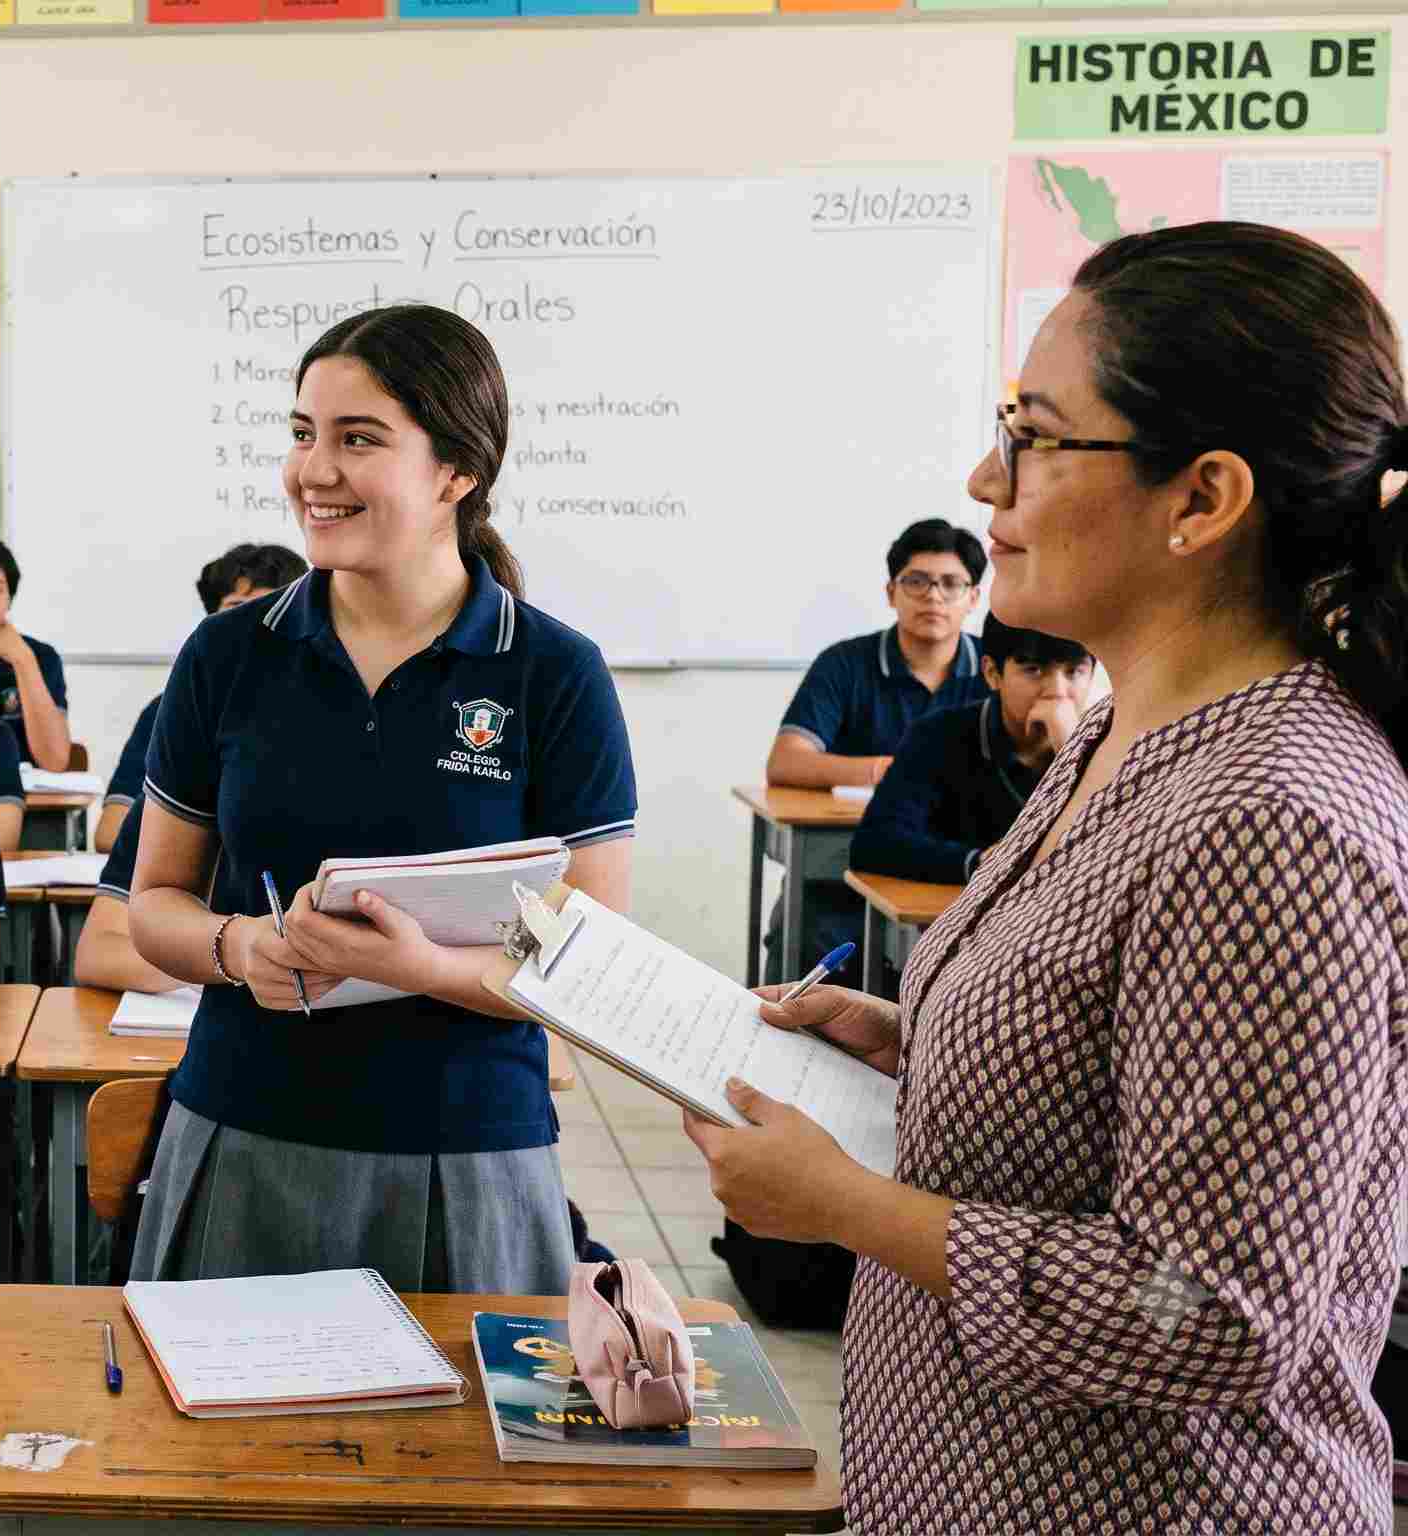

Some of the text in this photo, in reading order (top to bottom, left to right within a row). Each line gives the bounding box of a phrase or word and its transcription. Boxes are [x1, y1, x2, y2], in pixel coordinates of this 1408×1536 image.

[1029, 38, 1376, 84] HISTORIA DE
[1110, 83, 1309, 132] MÉXICO
[811, 184, 972, 224] 23/10/2023
[202, 209, 656, 270] Ecosistemas y Conservación
[454, 281, 575, 322] Orales
[535, 403, 547, 425] y
[513, 498, 527, 524] y
[436, 758, 512, 781] FRIDA KAHLO
[450, 751, 501, 767] COLEGIO
